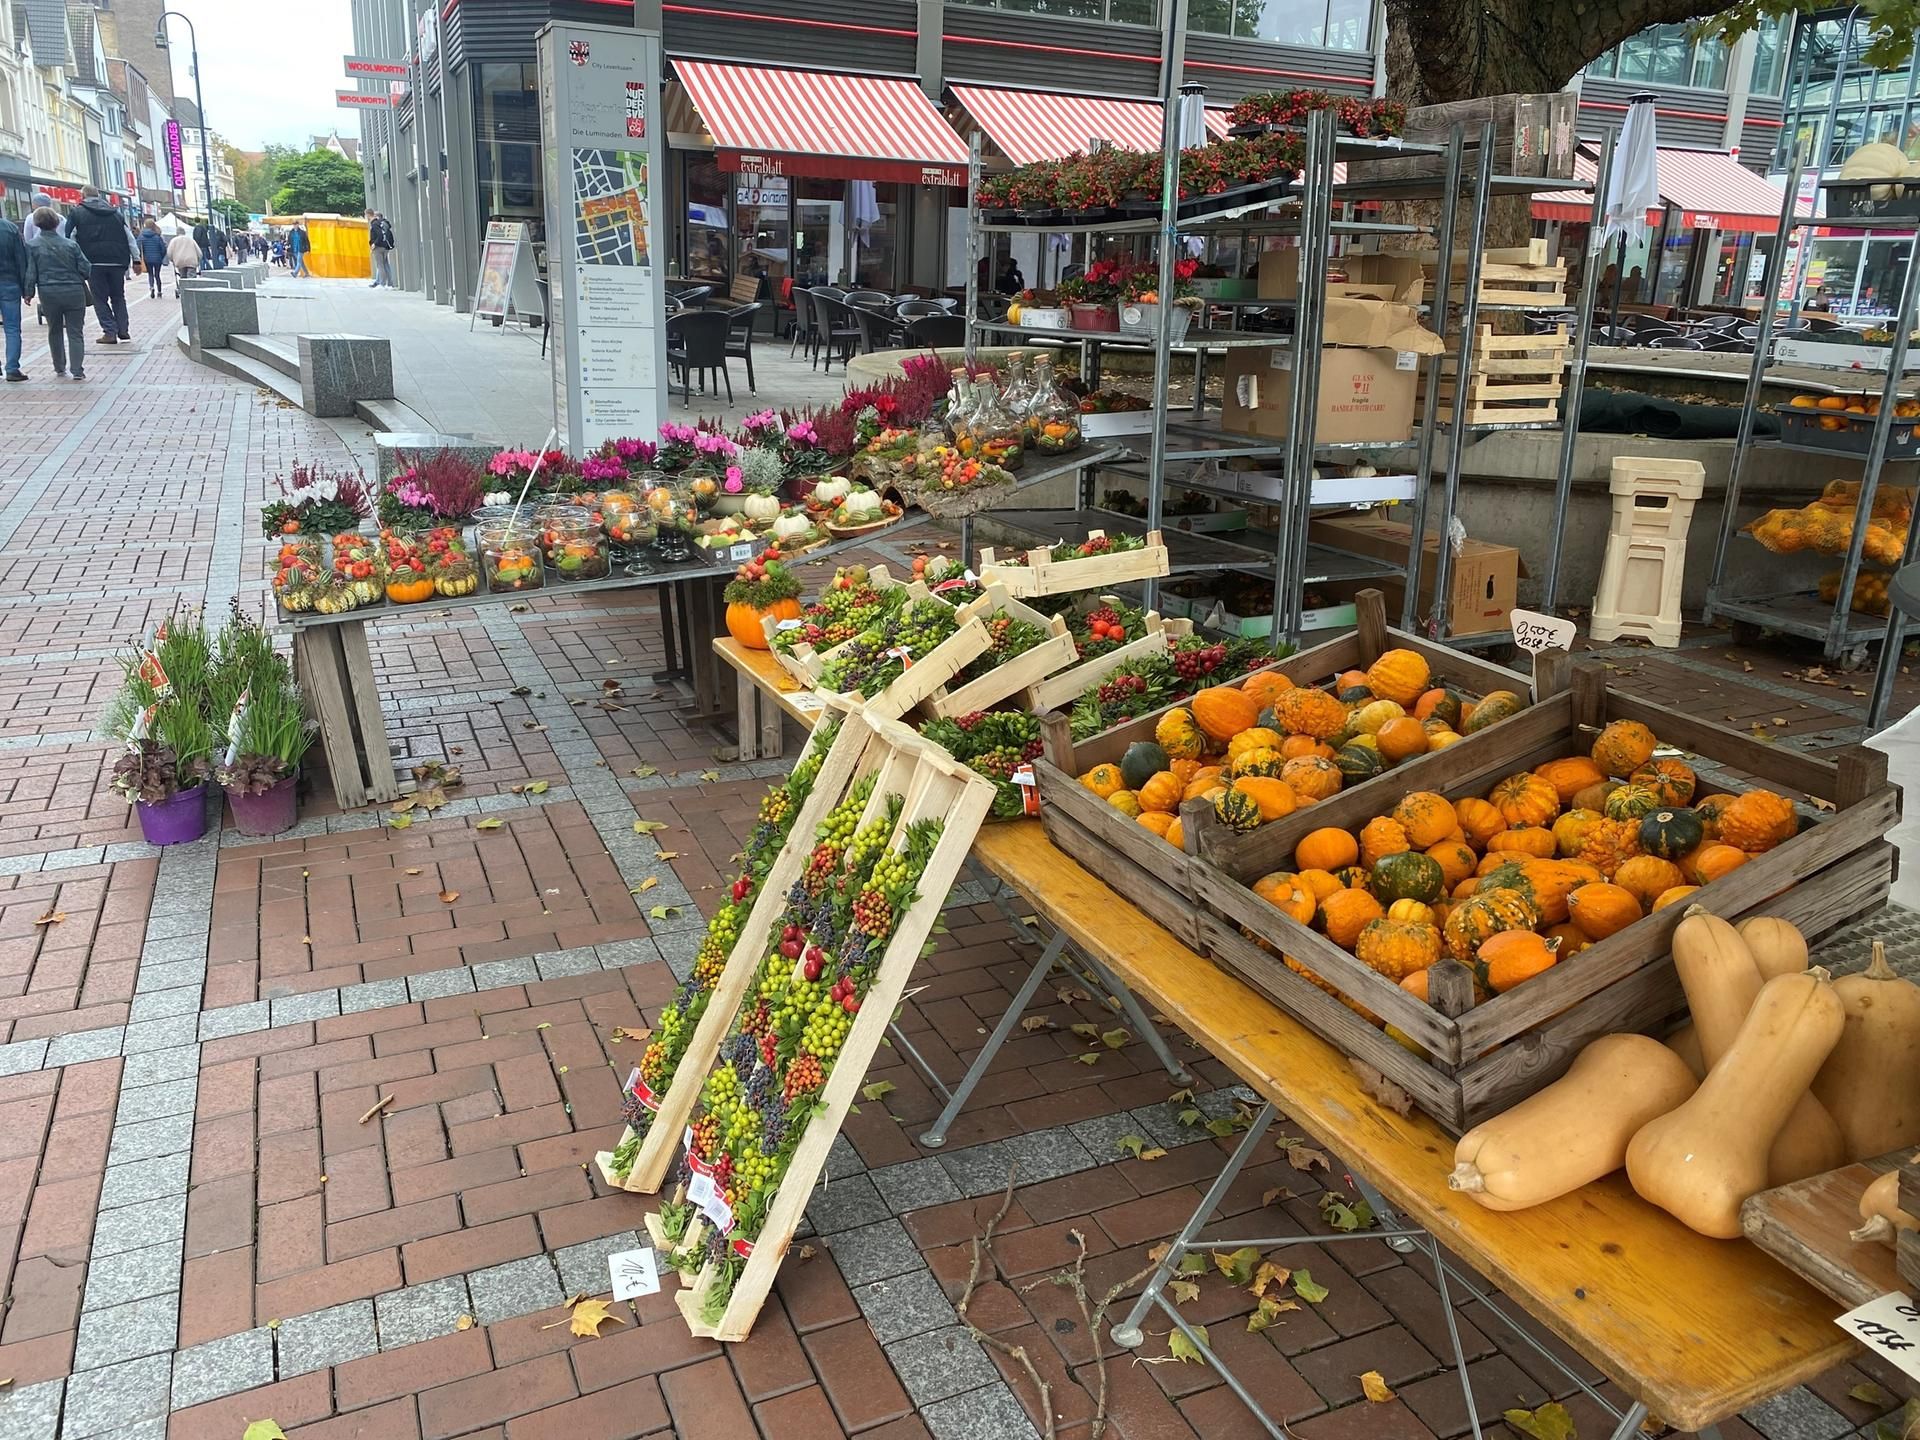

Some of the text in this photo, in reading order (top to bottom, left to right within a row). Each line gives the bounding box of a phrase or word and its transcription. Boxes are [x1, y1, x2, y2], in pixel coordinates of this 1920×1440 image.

[347, 62, 406, 75] WOOLWORTH
[338, 95, 388, 105] WOOLWORTH
[625, 88, 645, 100] NUR
[626, 99, 645, 110] DER
[572, 128, 623, 139] Die Luminaden
[740, 157, 784, 175] extrablatt
[922, 169, 961, 186] extrablatt
